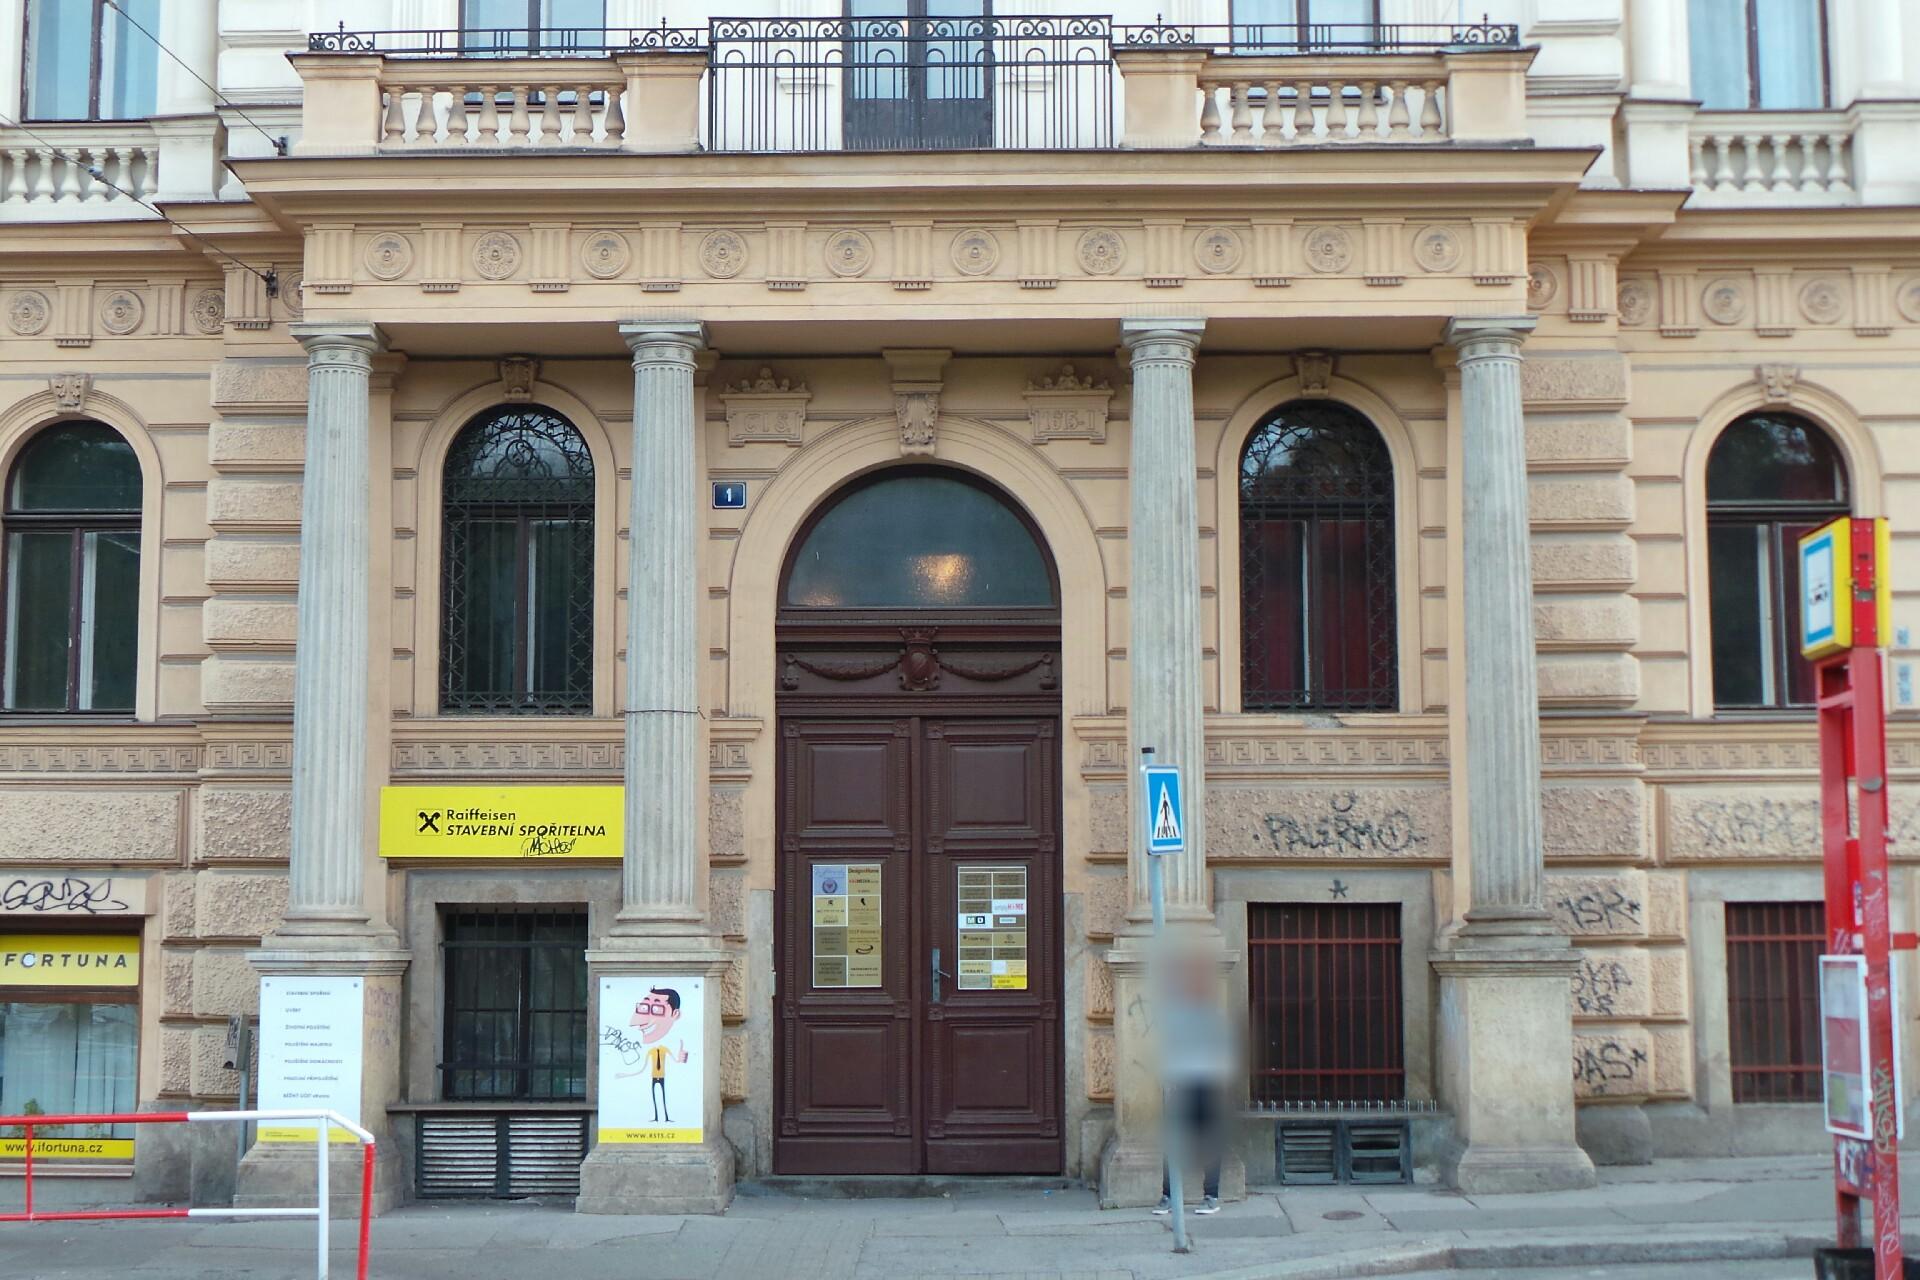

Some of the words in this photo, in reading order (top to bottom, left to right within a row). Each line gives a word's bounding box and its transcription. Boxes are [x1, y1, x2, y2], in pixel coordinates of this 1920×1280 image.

[726, 487, 732, 502] 1
[446, 809, 516, 821] Raiffeisen
[446, 822, 514, 836] STAVEBNÍ
[518, 822, 606, 836] SPOŘITELNA
[5, 952, 127, 969] FORTUNA
